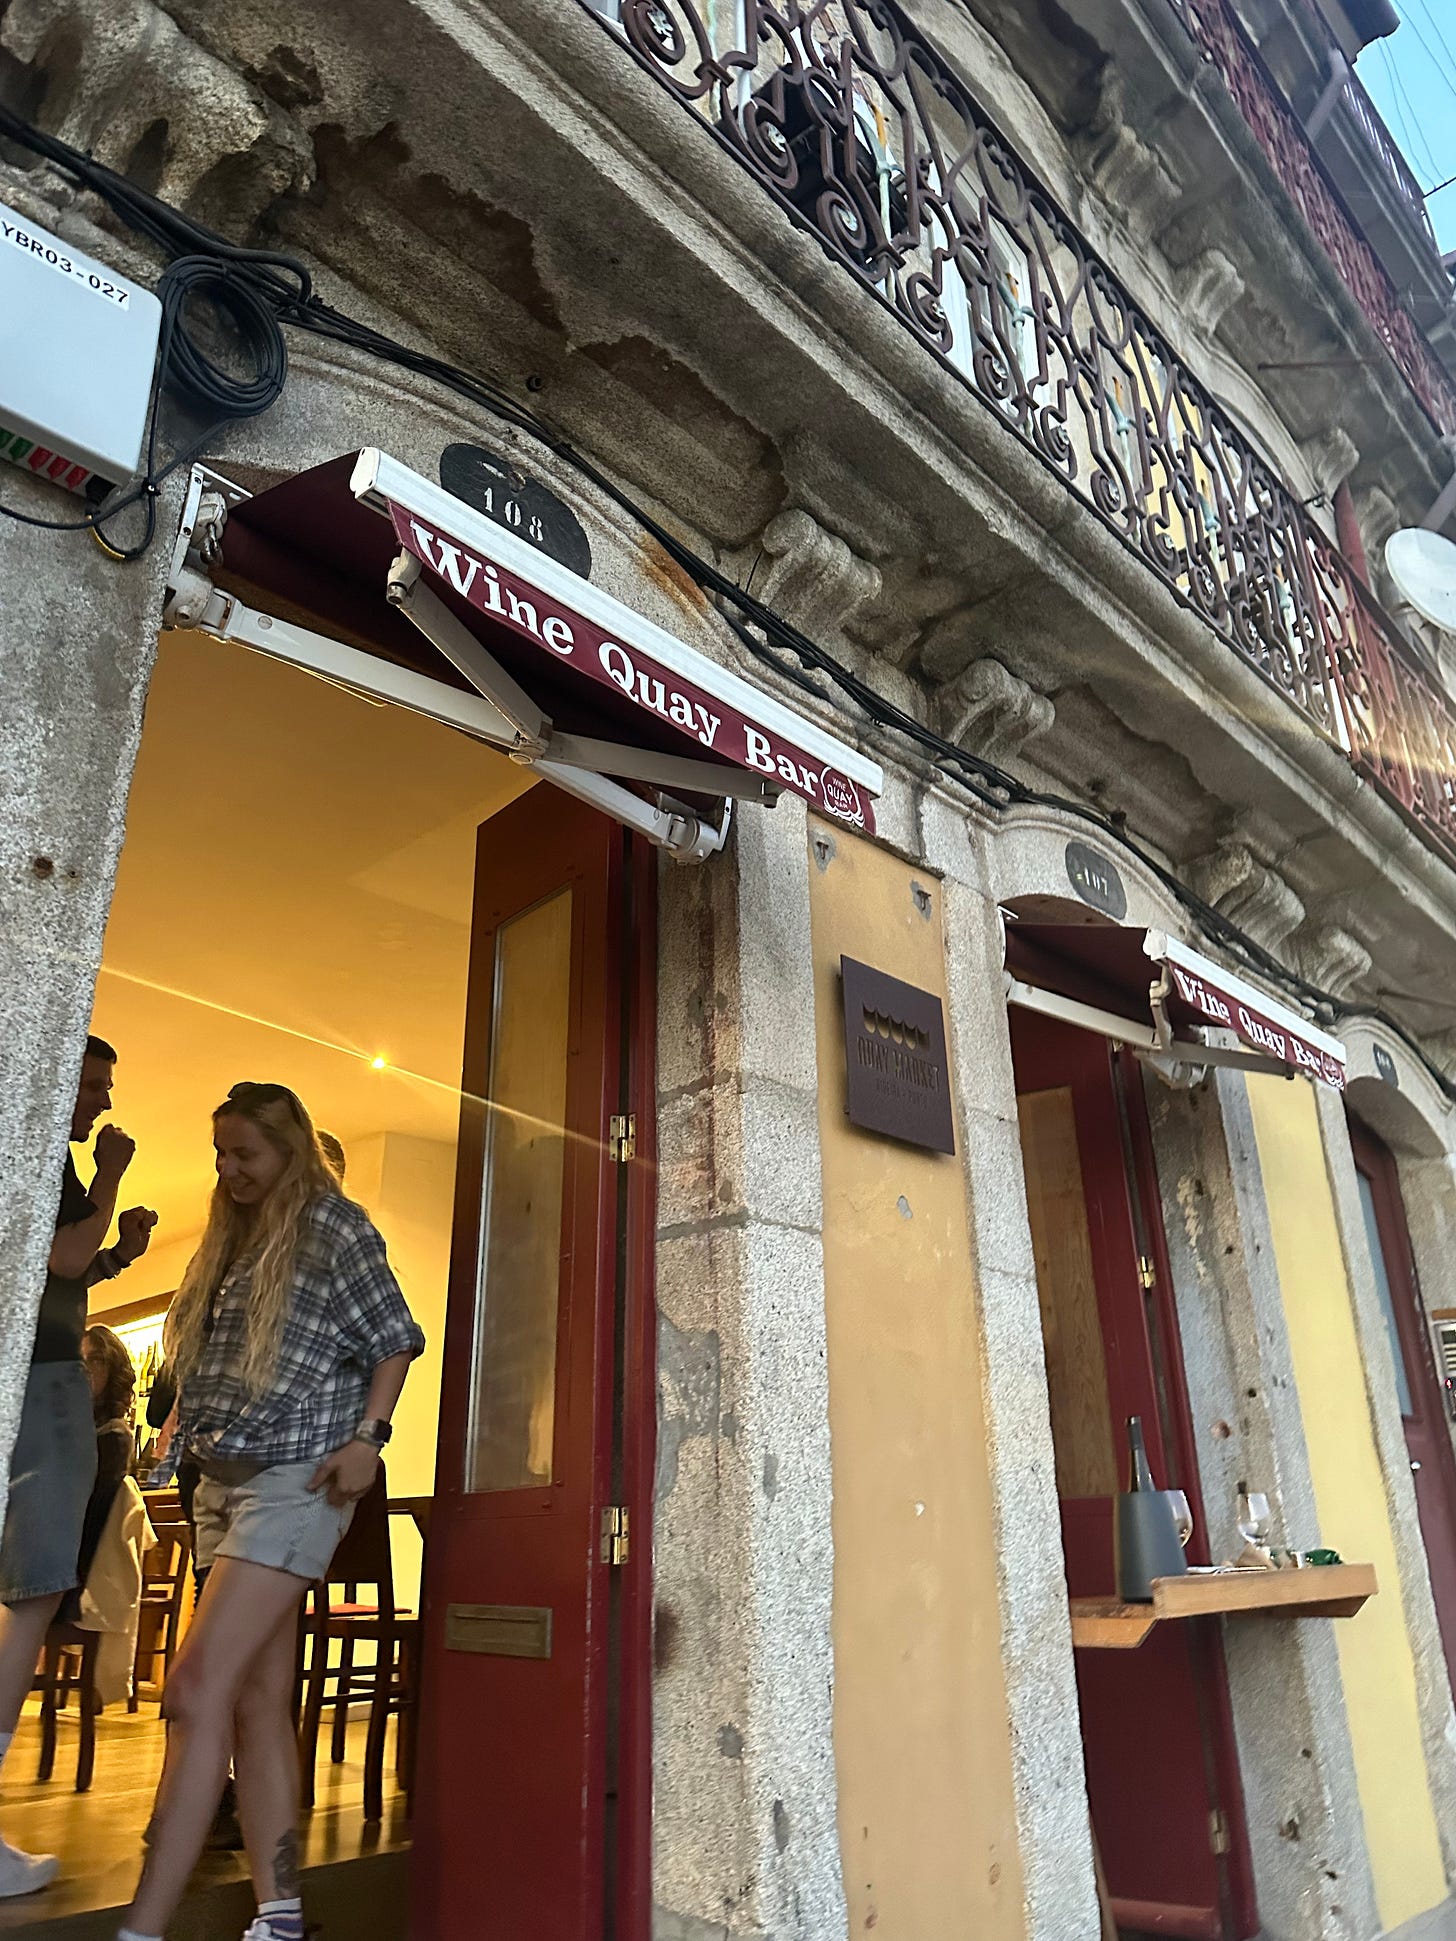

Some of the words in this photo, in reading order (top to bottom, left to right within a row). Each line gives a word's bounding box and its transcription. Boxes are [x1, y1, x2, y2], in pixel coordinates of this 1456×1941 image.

[2, 221, 128, 303] YBR03-027
[484, 487, 543, 541] 108
[410, 520, 574, 655] Wine
[599, 642, 720, 747] Quay
[743, 724, 819, 797] Bar
[827, 783, 853, 805] QUAY
[1174, 968, 1231, 1025] Wine
[1238, 1007, 1286, 1060] Quay
[1290, 1036, 1322, 1077] Bar
